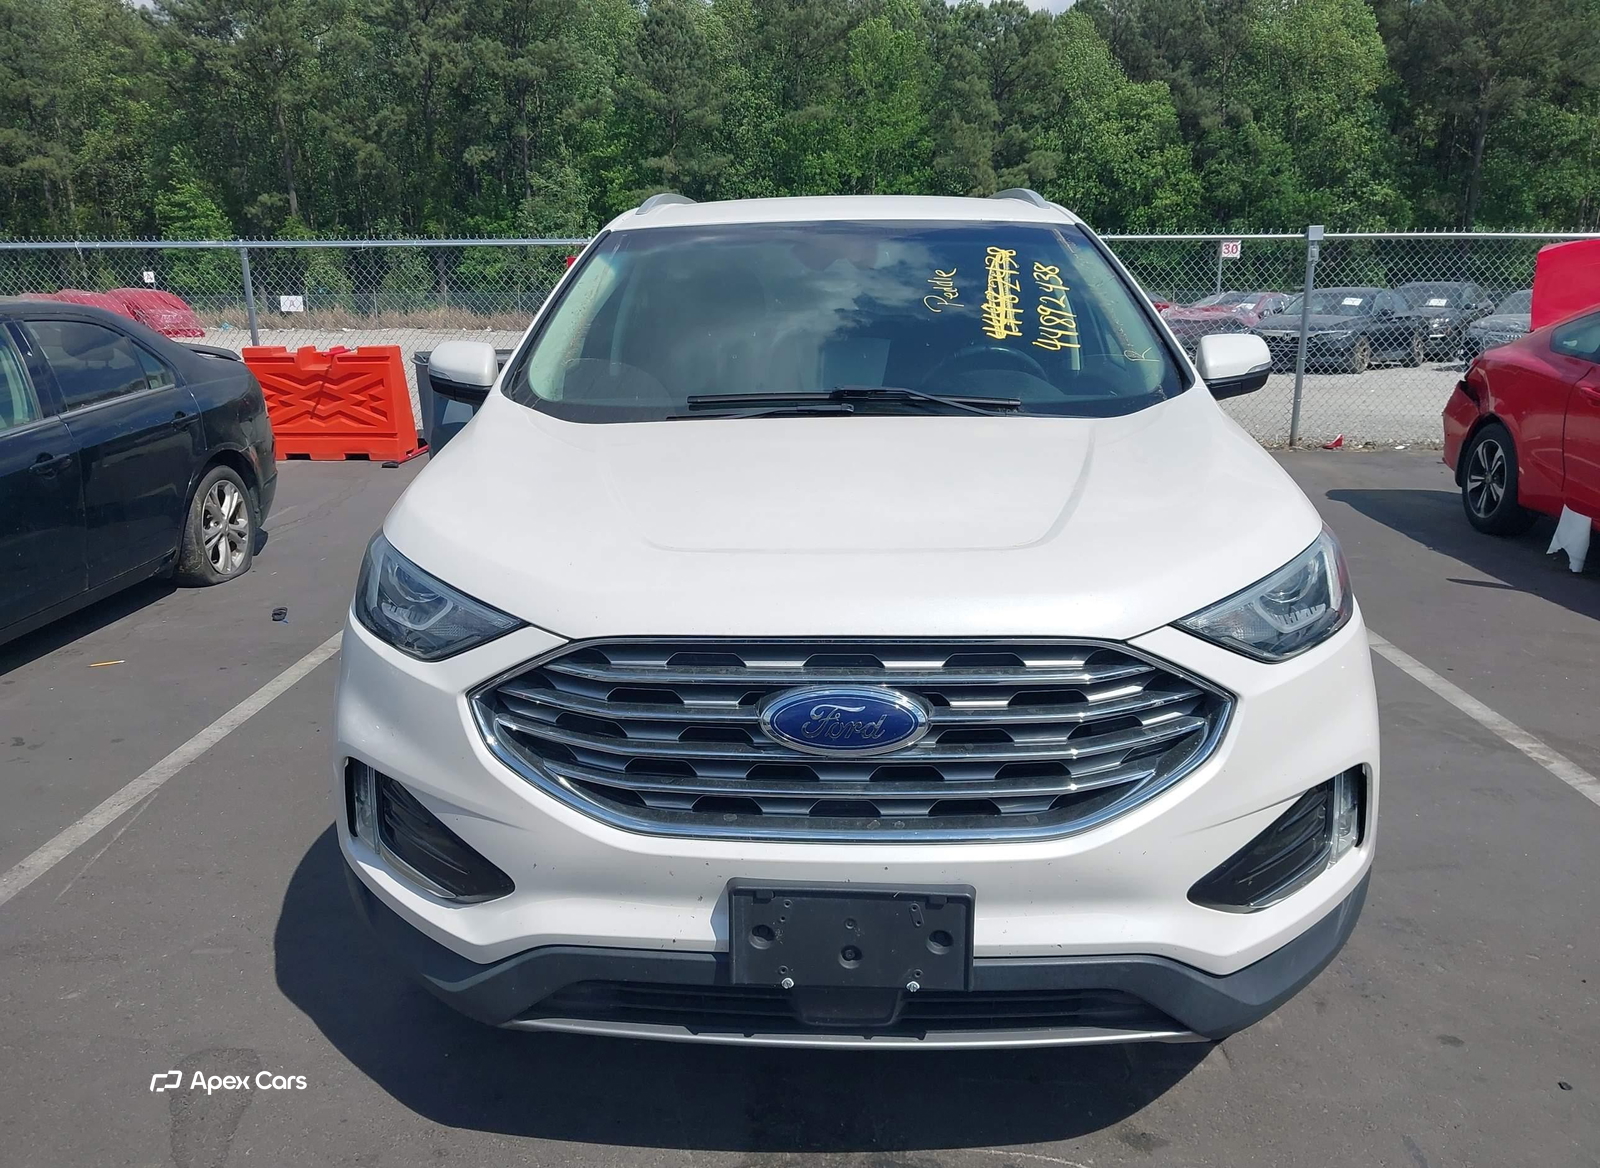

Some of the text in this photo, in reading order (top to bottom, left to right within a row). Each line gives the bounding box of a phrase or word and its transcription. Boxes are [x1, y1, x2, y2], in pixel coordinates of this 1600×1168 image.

[1223, 244, 1238, 255] 30
[1032, 261, 1081, 350] 44892438
[801, 704, 888, 740] Ford
